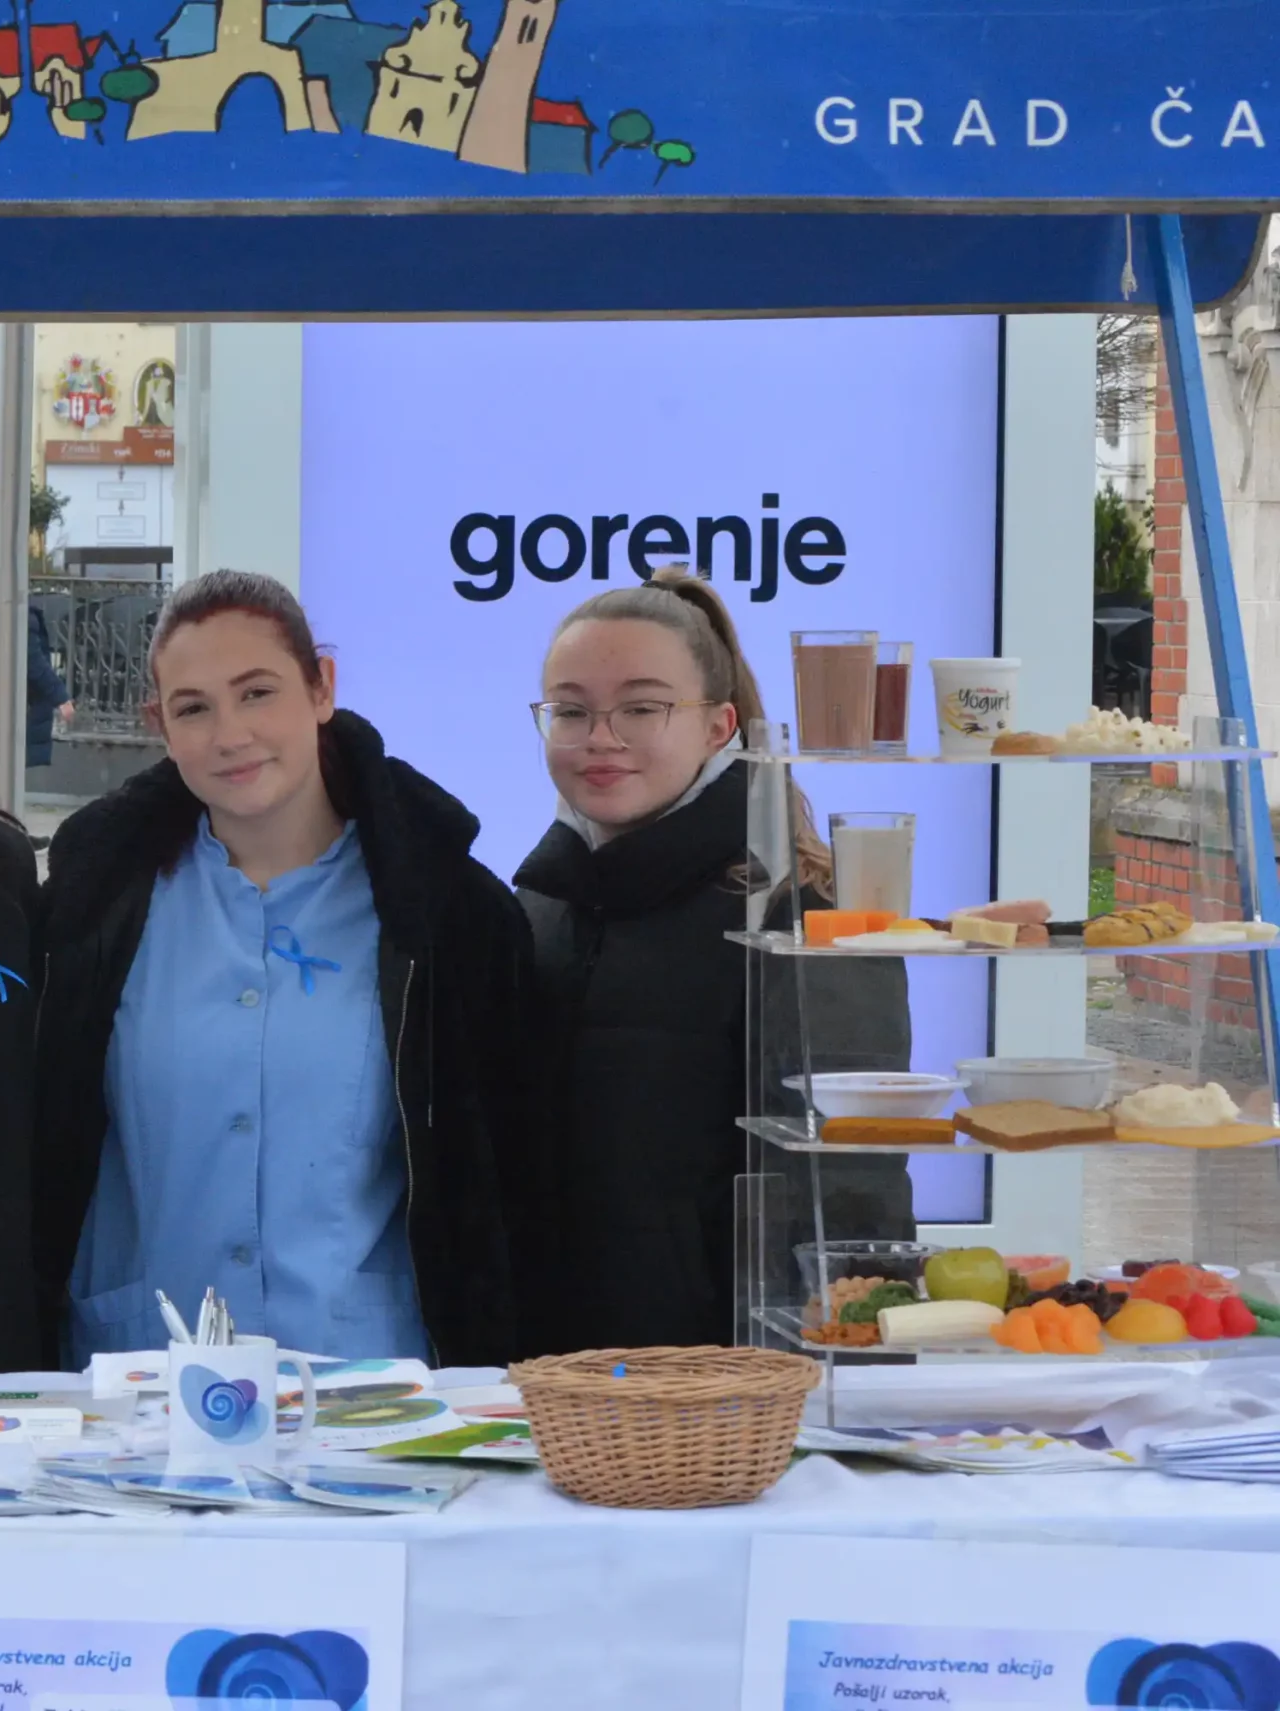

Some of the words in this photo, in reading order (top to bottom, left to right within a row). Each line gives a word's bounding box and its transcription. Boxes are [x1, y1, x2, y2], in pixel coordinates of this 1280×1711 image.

[814, 95, 1069, 147] GRAD
[1150, 86, 1266, 148] ČA
[449, 492, 847, 602] gorenje
[958, 688, 1011, 715] Yogurt
[74, 1650, 132, 1672] akcija
[818, 1651, 989, 1675] Javnozdravstvena
[997, 1657, 1055, 1680] akcija
[833, 1681, 887, 1702] Pošalji
[893, 1684, 951, 1704] uzorak,
